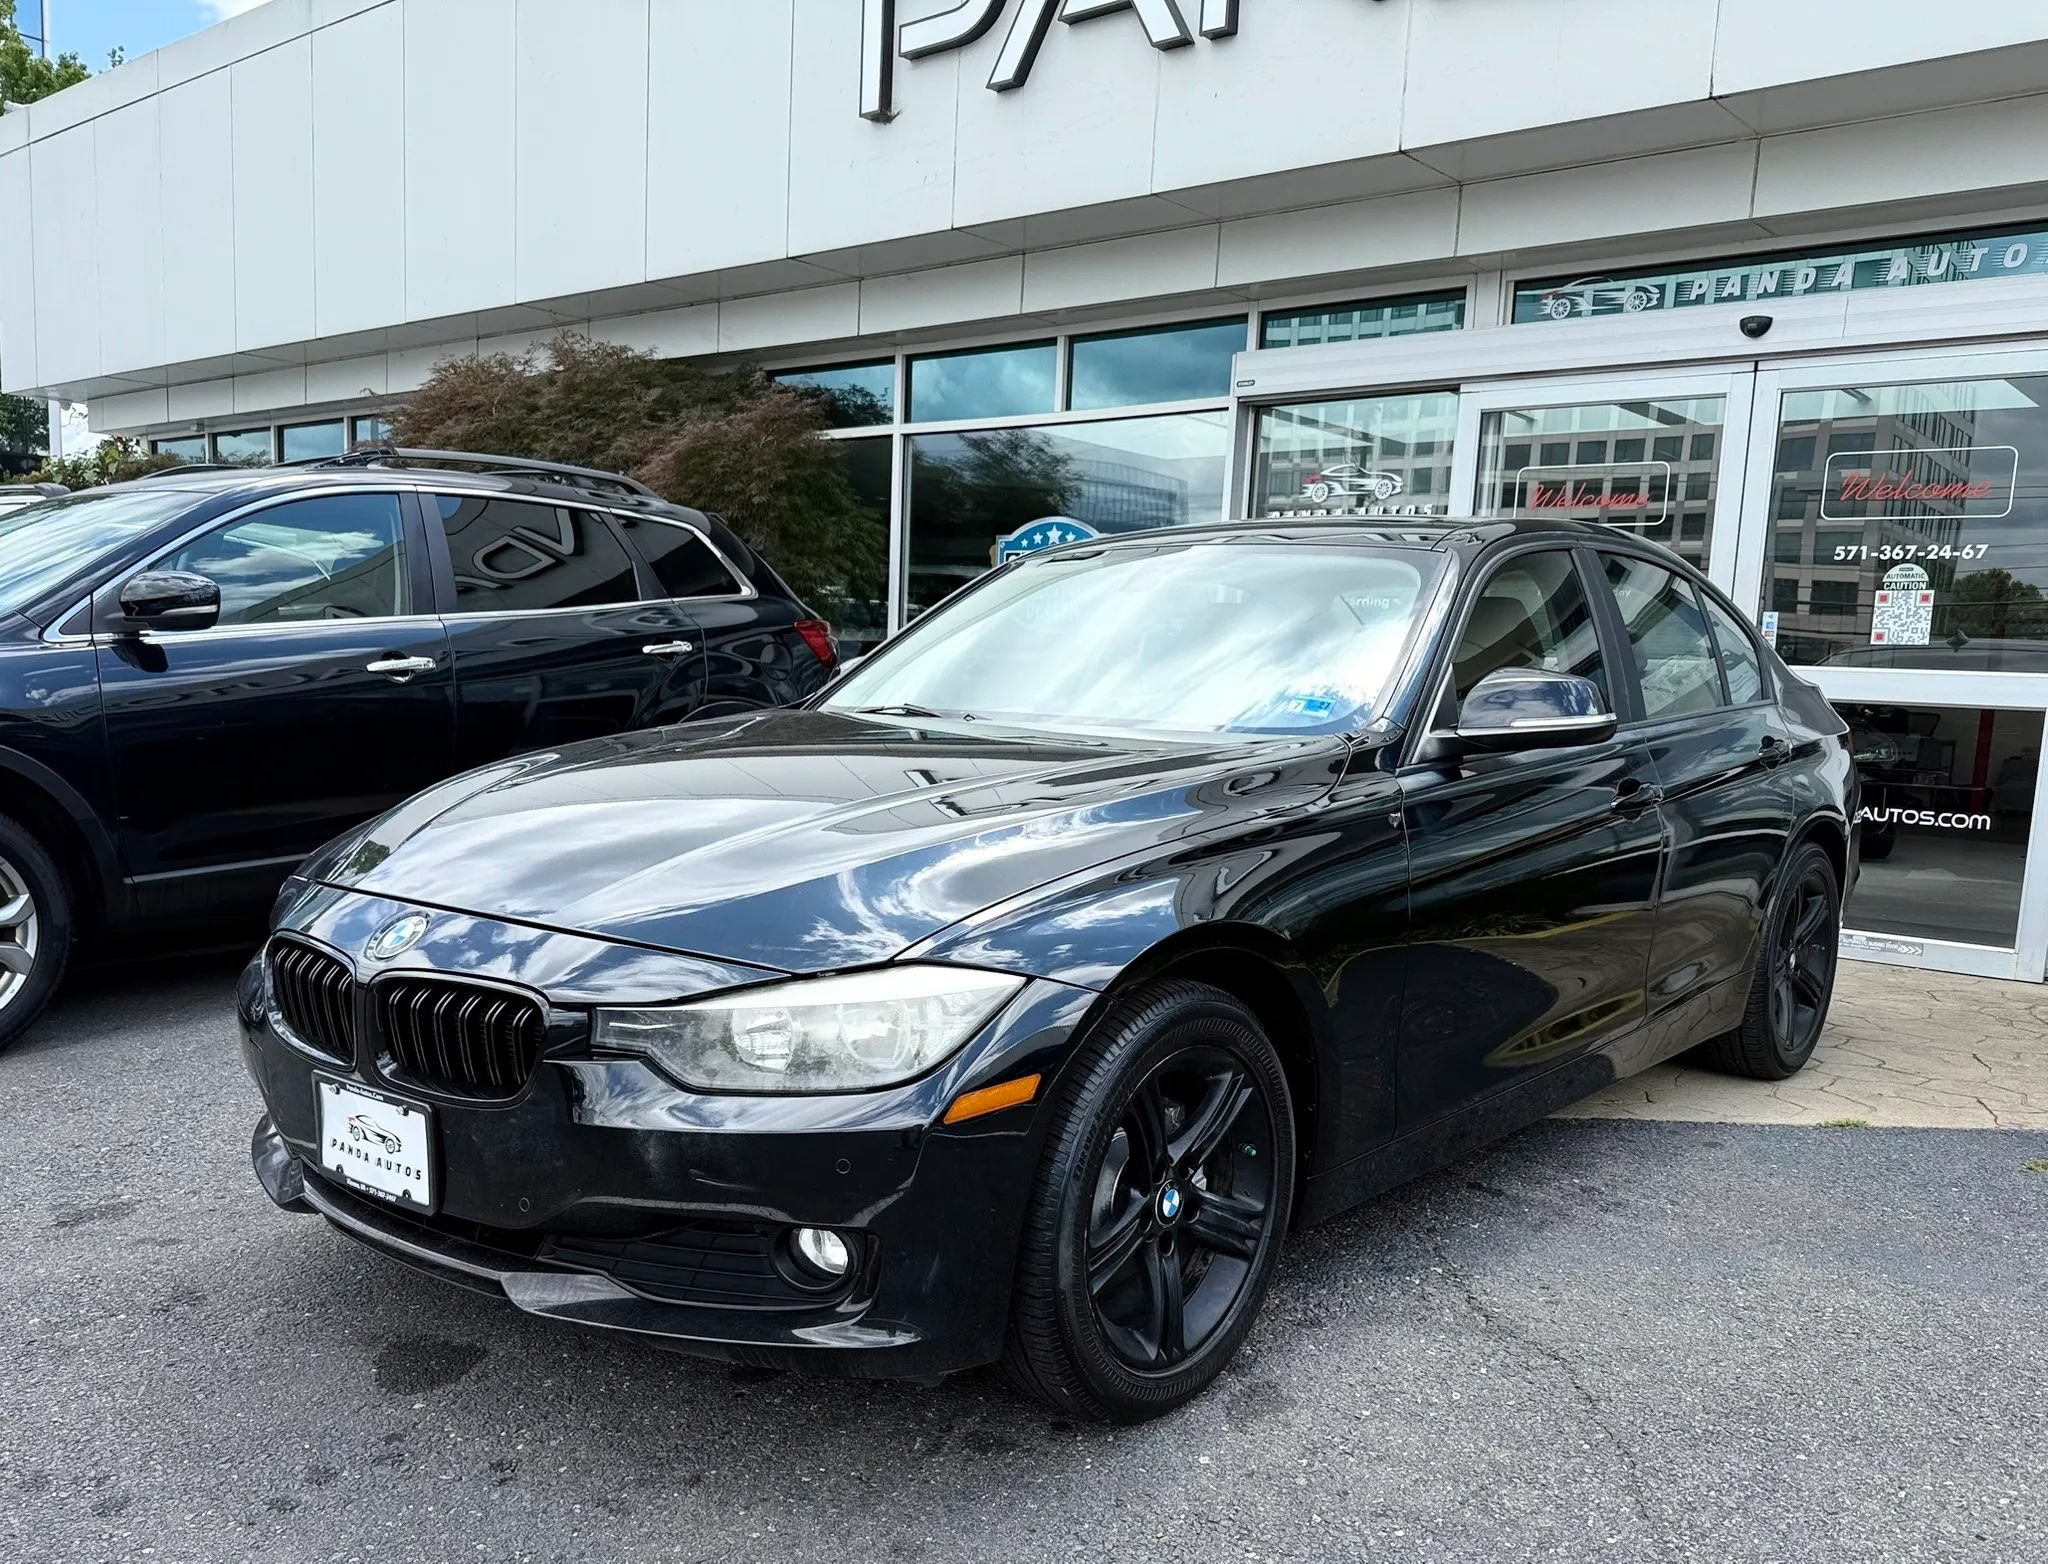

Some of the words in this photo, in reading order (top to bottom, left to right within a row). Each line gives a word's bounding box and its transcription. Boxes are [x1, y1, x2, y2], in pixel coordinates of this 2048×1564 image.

[860, 0, 1237, 121] PA
[1688, 262, 1855, 300] PANDA
[1885, 243, 2048, 282] AUTO
[1529, 481, 1650, 512] Welcome
[1840, 469, 1994, 501] Welcome
[1358, 504, 1433, 516] AUTOS
[1833, 544, 1990, 560] 571-367-24-67
[1883, 581, 1927, 590] CAUTION
[1886, 572, 1925, 580] AUTOMATIC
[1318, 701, 1331, 710] 27
[331, 1138, 369, 1163] PANDA
[376, 1157, 422, 1181] AUTOS
